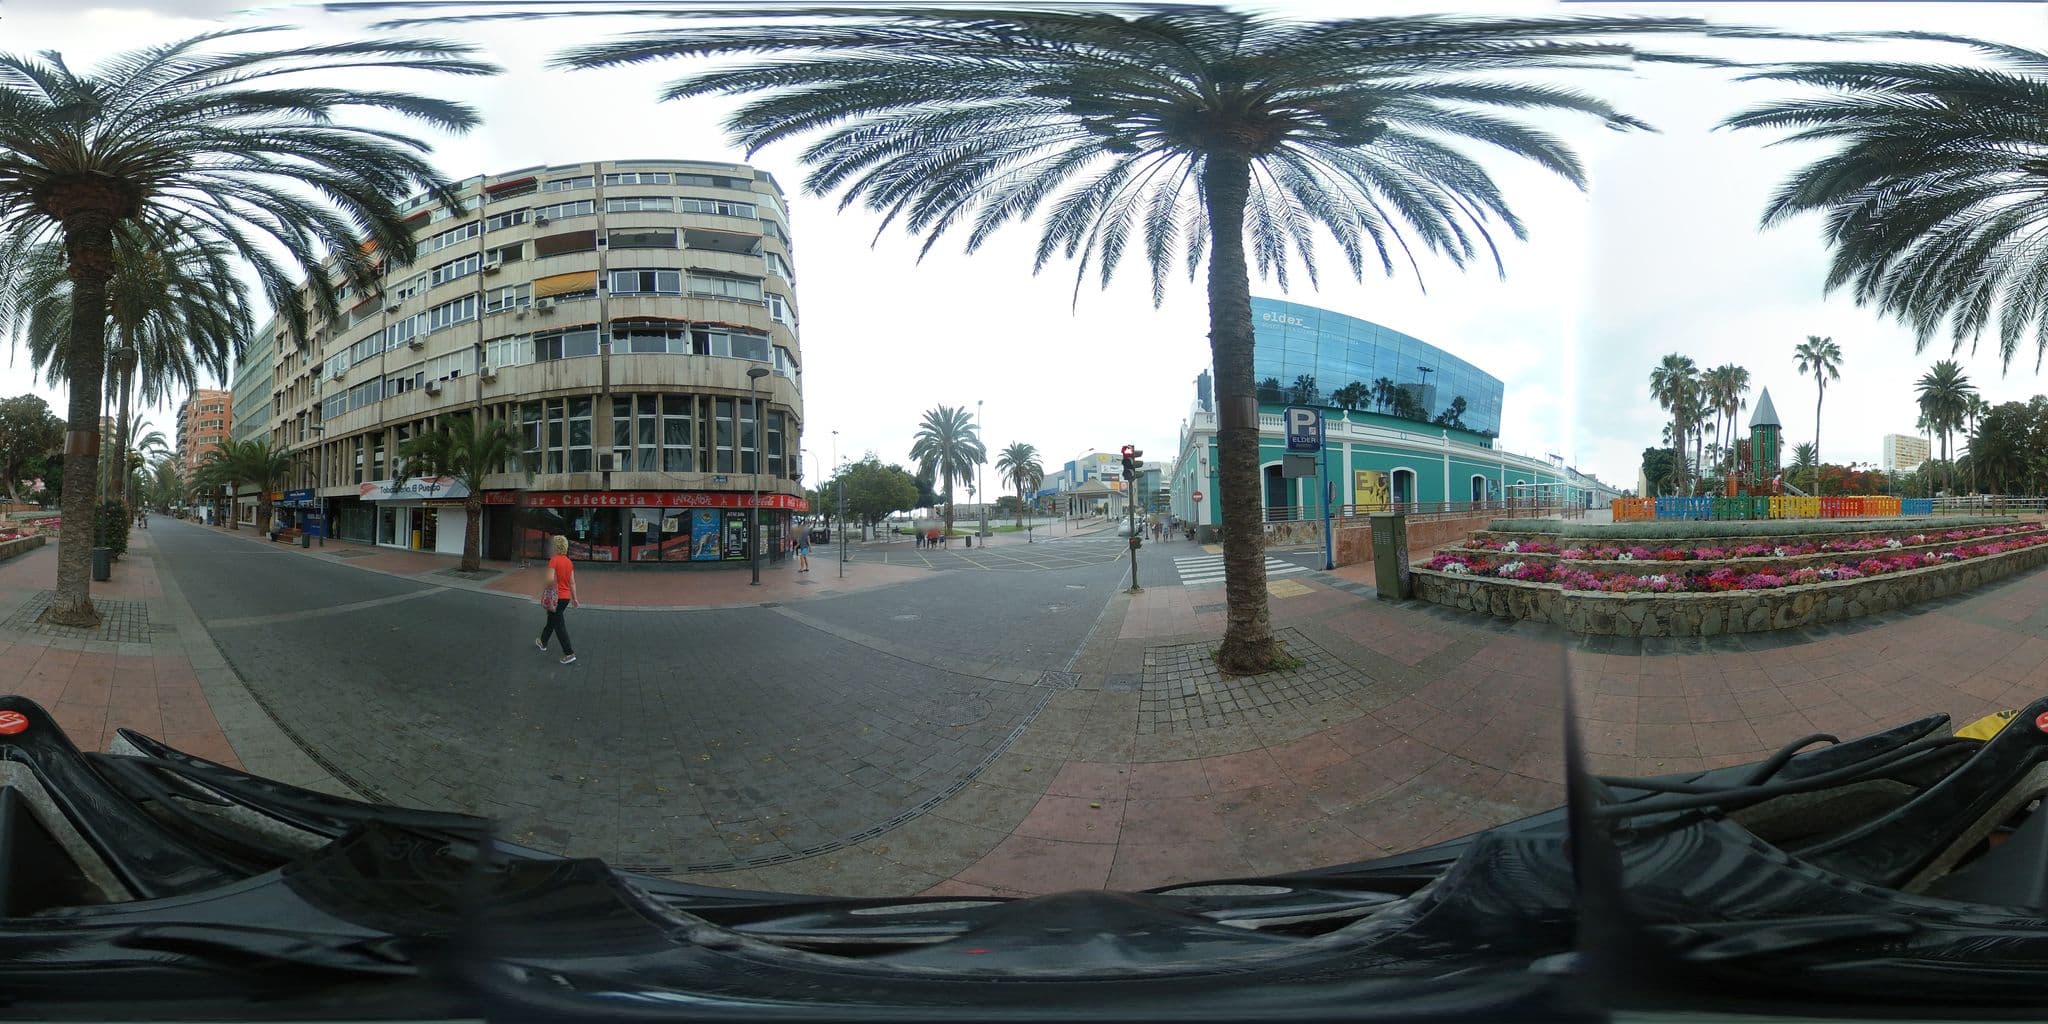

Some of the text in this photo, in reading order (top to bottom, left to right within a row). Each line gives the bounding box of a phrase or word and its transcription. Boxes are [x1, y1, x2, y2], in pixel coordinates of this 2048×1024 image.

[1291, 408, 1316, 435] P
[1292, 436, 1316, 444] ELDER
[673, 494, 713, 506] LANZAROTE
